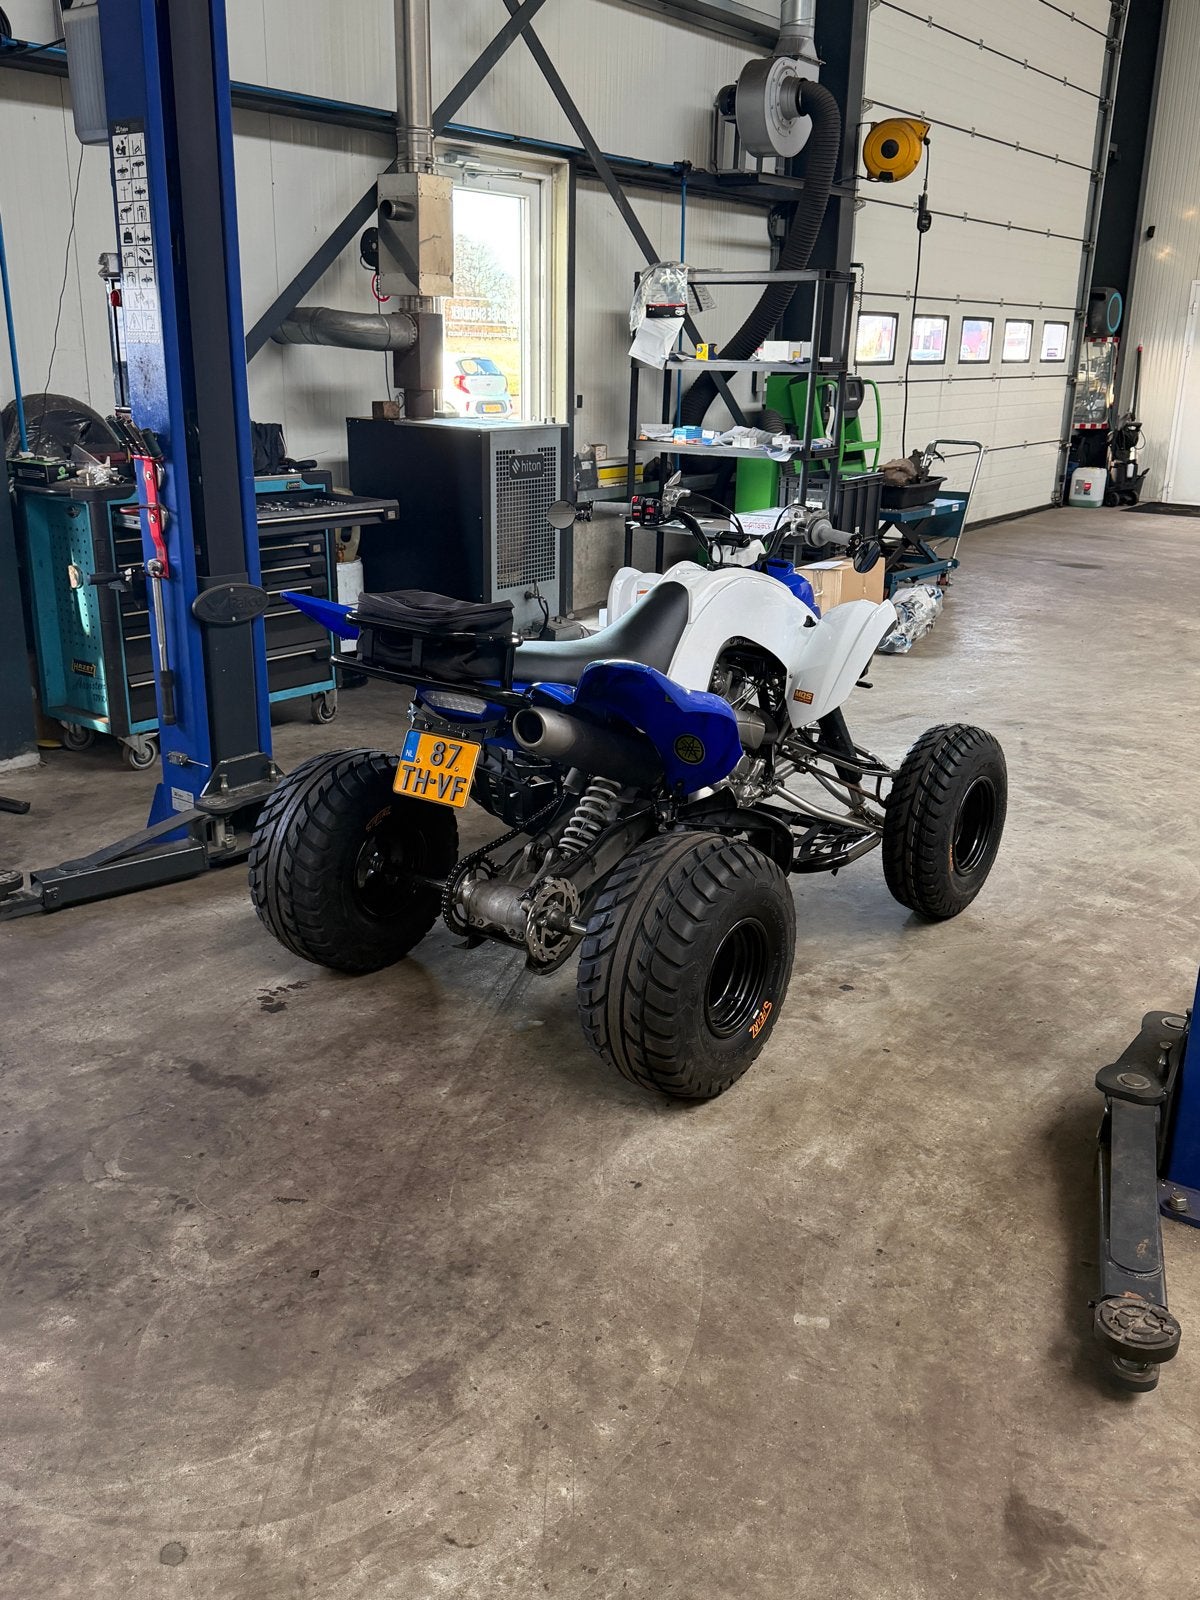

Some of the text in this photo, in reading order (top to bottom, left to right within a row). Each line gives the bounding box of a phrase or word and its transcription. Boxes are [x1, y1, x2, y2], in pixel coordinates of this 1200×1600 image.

[521, 460, 542, 472] hiton
[72, 660, 95, 675] HAZET
[405, 749, 413, 758] NL
[430, 741, 463, 769] 87
[402, 765, 467, 801] TH-VF
